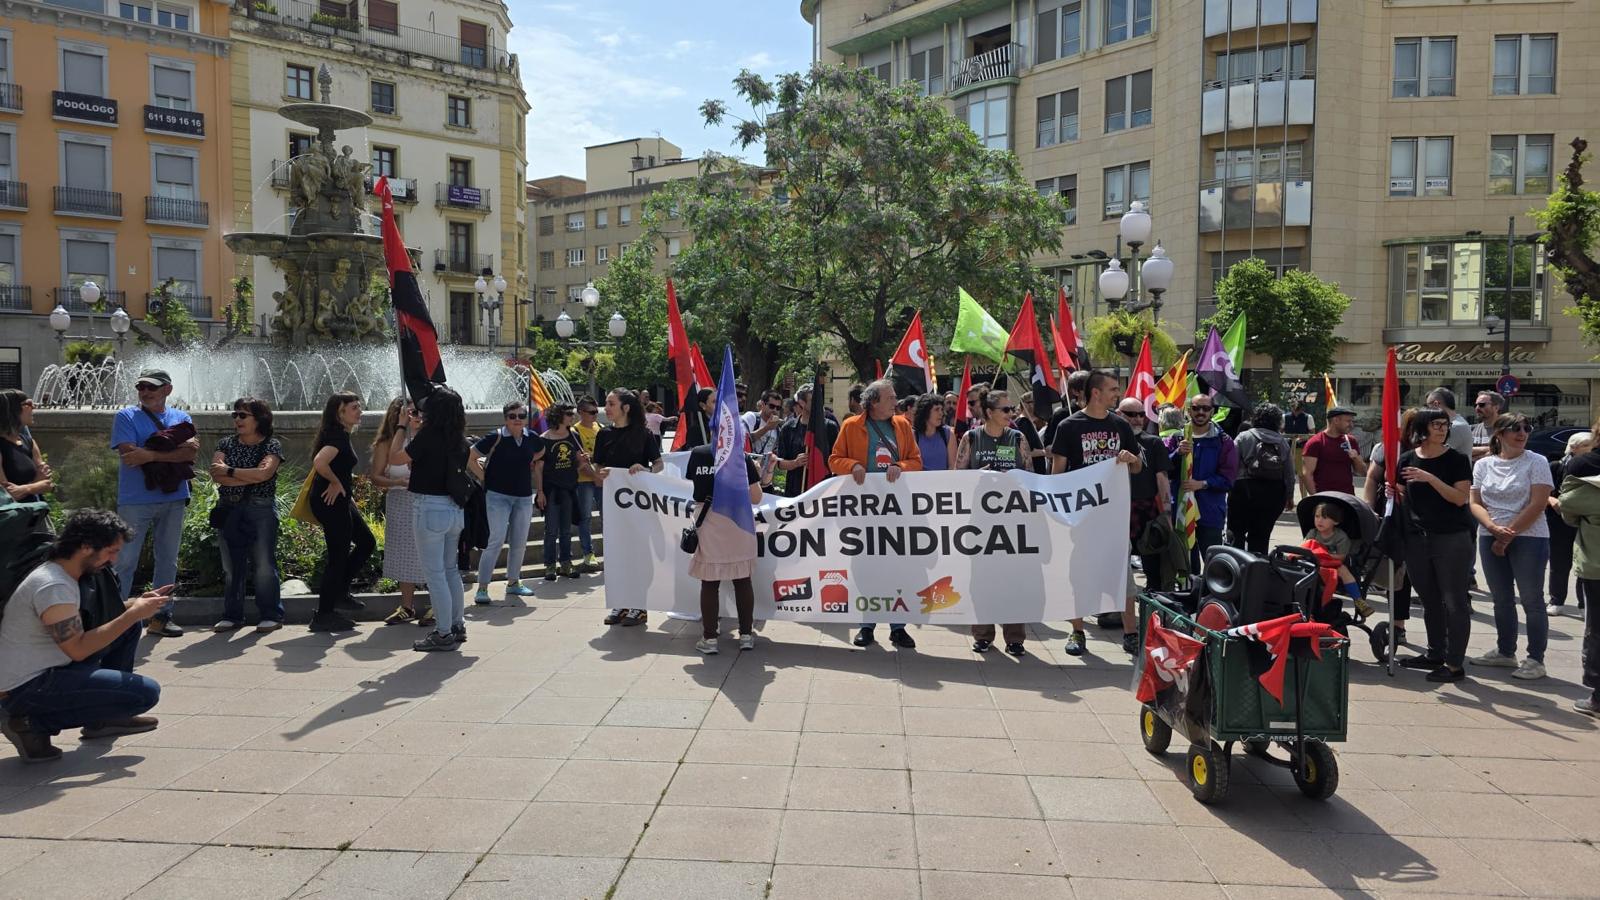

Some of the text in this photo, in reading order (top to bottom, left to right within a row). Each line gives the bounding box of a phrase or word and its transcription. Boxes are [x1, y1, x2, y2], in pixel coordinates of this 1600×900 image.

[56, 98, 115, 115] PODÓLOGO
[148, 112, 163, 122] 611
[166, 115, 177, 124] 59
[1081, 431, 1108, 440] SOMOS
[614, 487, 696, 518] CONT
[774, 493, 903, 522] GUERRA
[911, 492, 972, 516] DEL
[980, 482, 1110, 514] CAPITAL
[757, 523, 1040, 558] IÓN SINDICAL
[778, 582, 808, 597] CNT
[777, 604, 812, 613] HUESCA
[823, 601, 847, 612] CGT
